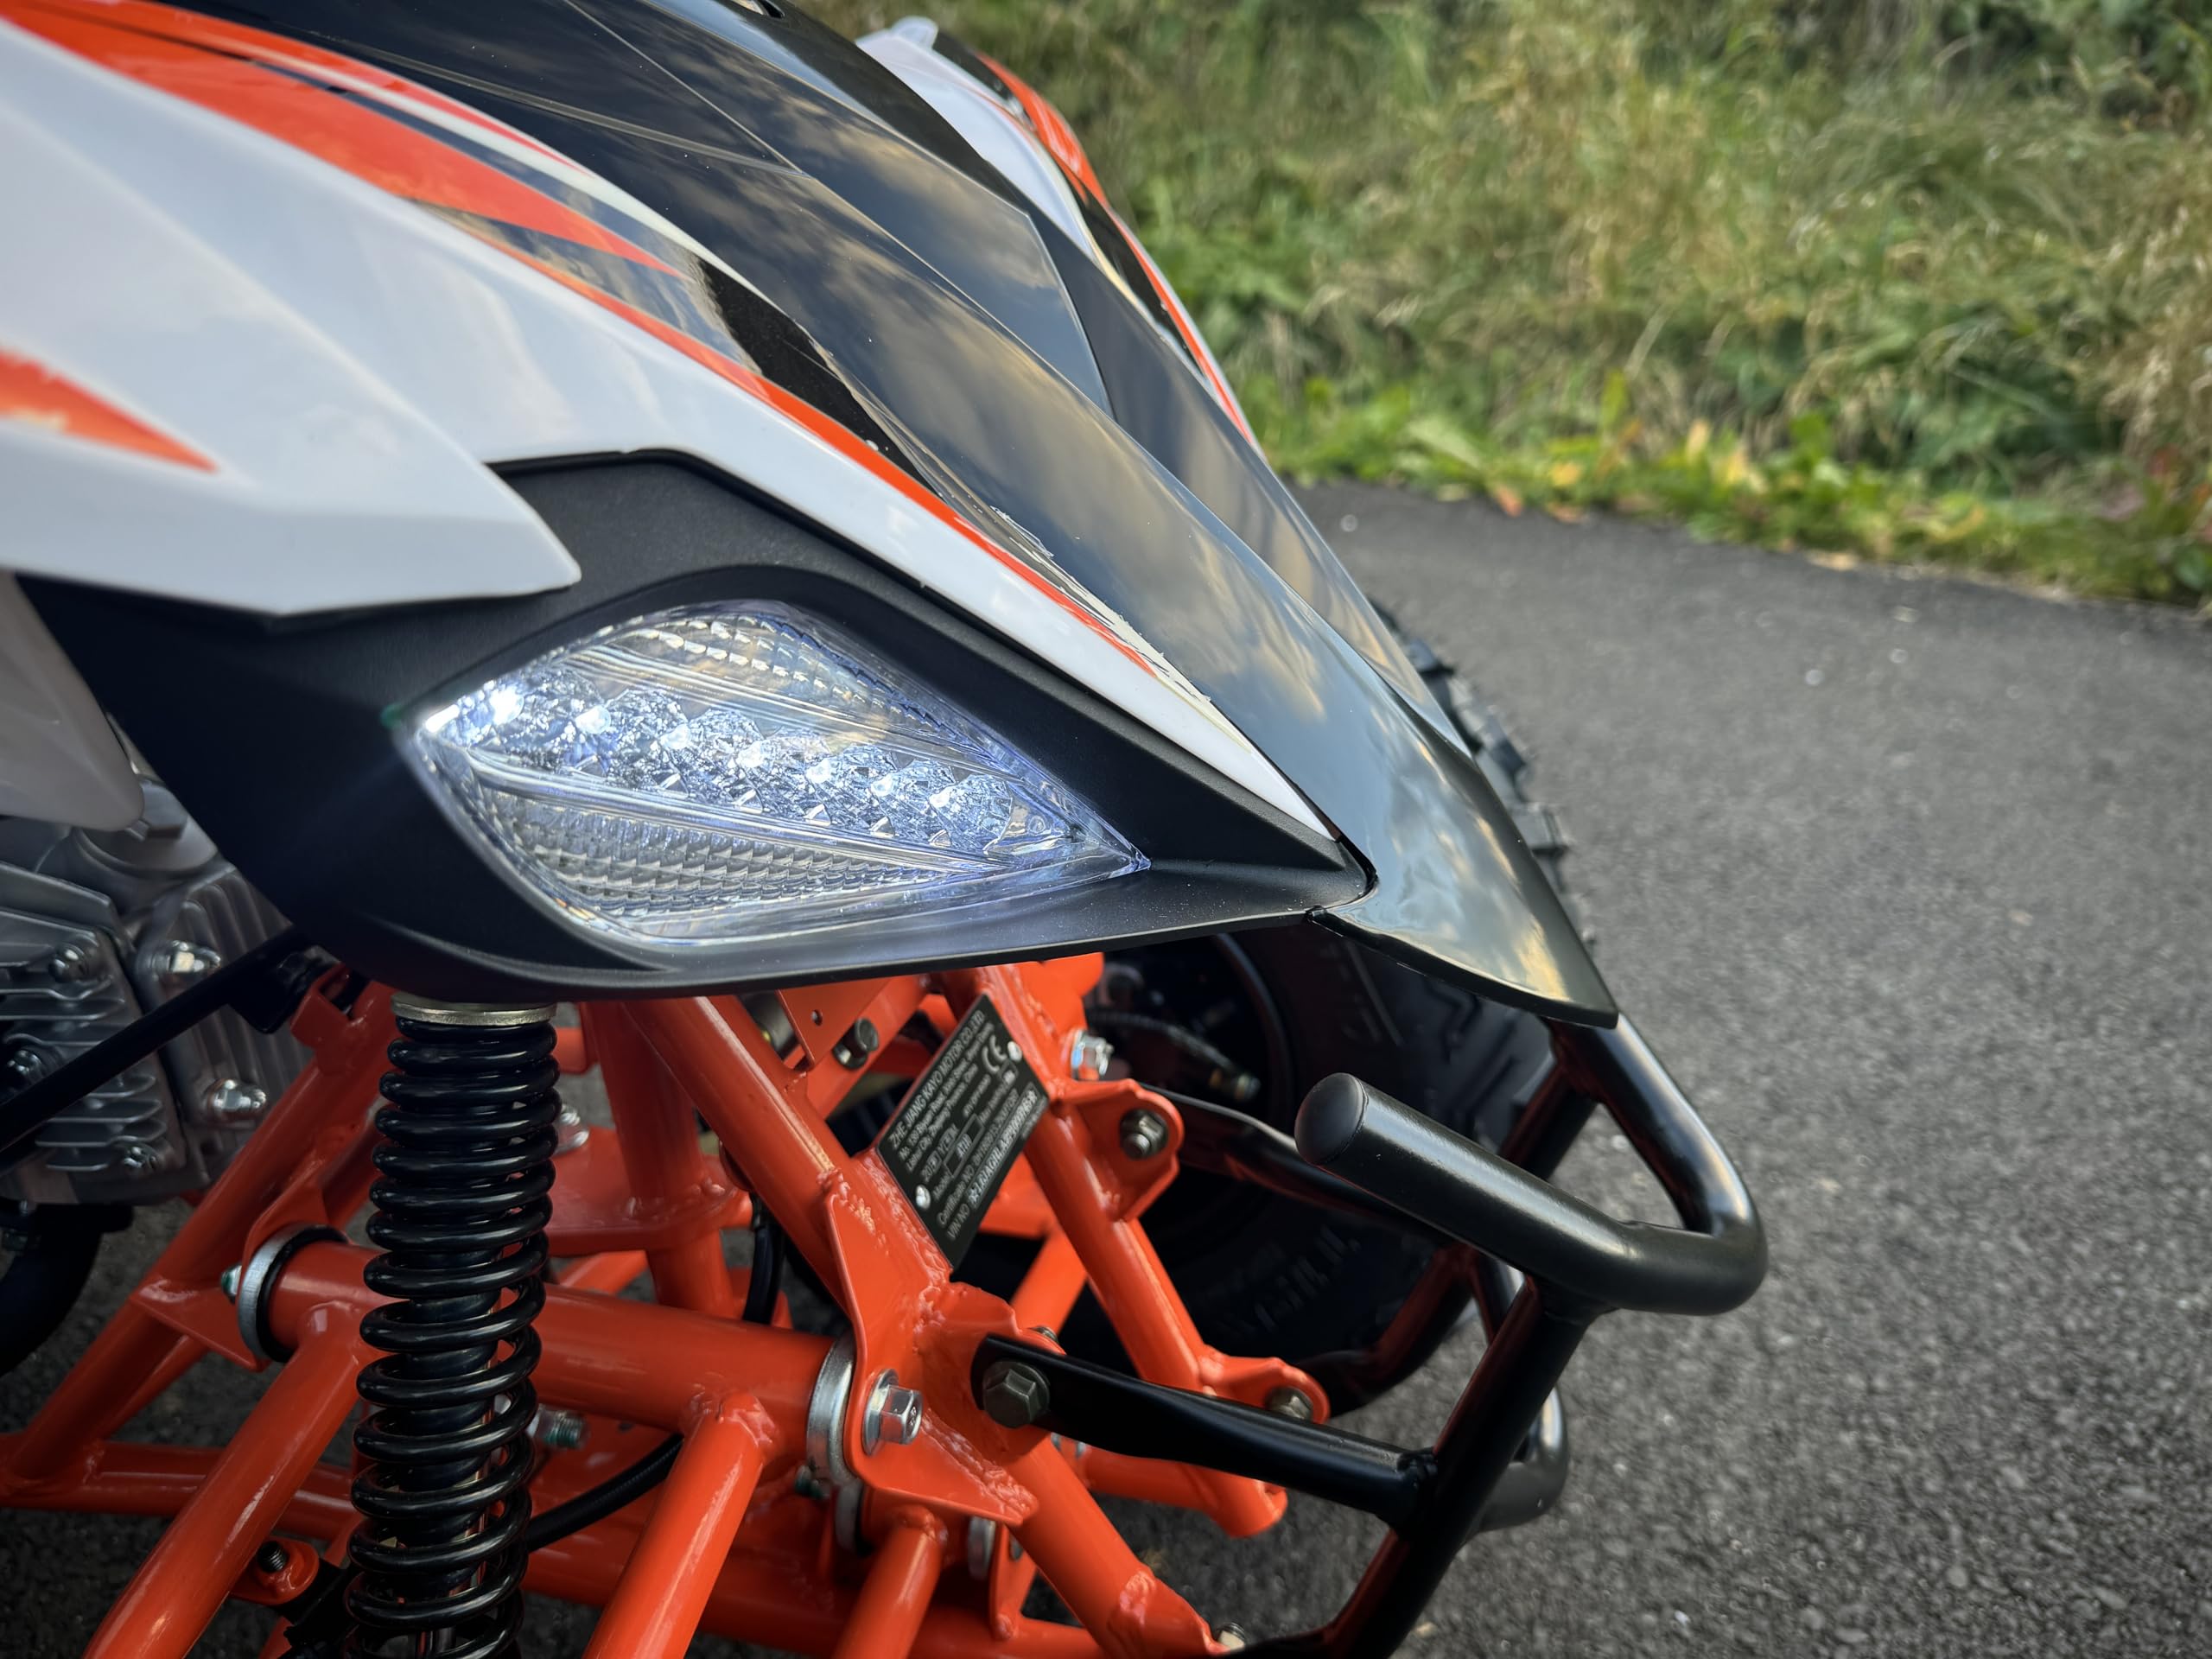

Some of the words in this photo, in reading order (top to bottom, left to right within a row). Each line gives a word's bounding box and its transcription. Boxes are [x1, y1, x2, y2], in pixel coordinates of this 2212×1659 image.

[982, 1034, 1007, 1072] CE
[889, 1122, 906, 1148] ZHE
[904, 1094, 925, 1128] JIANG
[923, 1070, 942, 1100] KAYO
[939, 1039, 963, 1076] MOTOR
